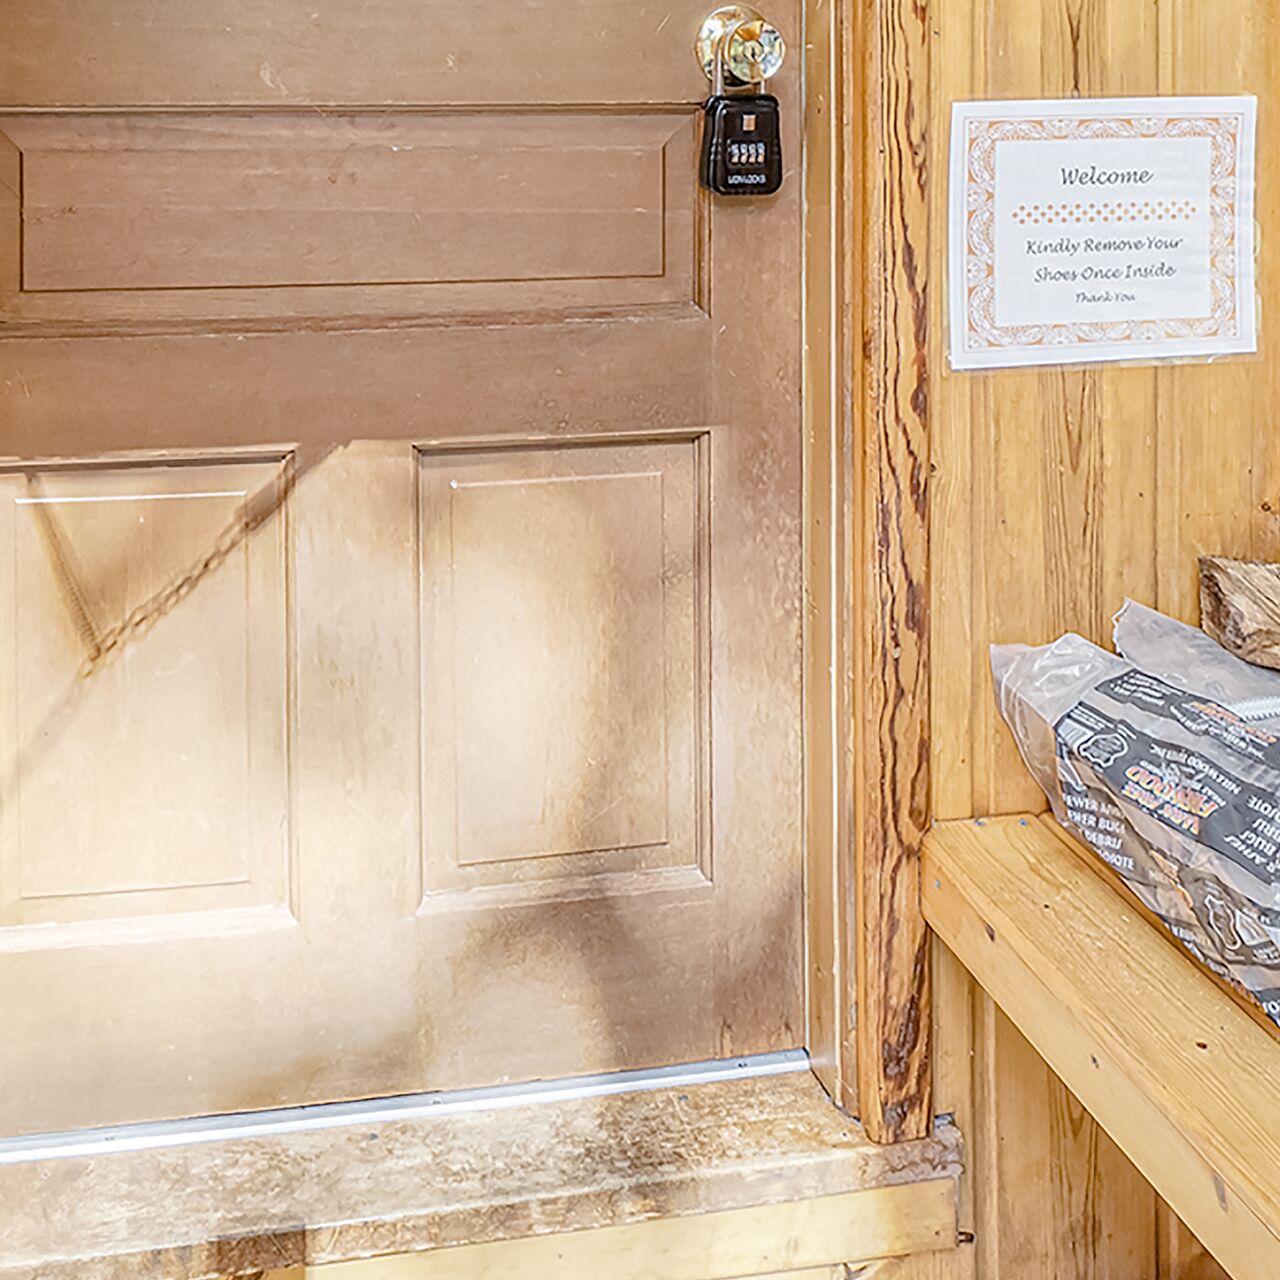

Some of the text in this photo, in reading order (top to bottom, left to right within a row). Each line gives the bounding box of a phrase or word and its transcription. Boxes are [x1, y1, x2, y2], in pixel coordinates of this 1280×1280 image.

[1061, 166, 1154, 185] Welcome
[1026, 236, 1183, 256] Kindly Remove Your
[1034, 262, 1176, 282] Shoes Once Inside
[1075, 291, 1136, 302] Thank You
